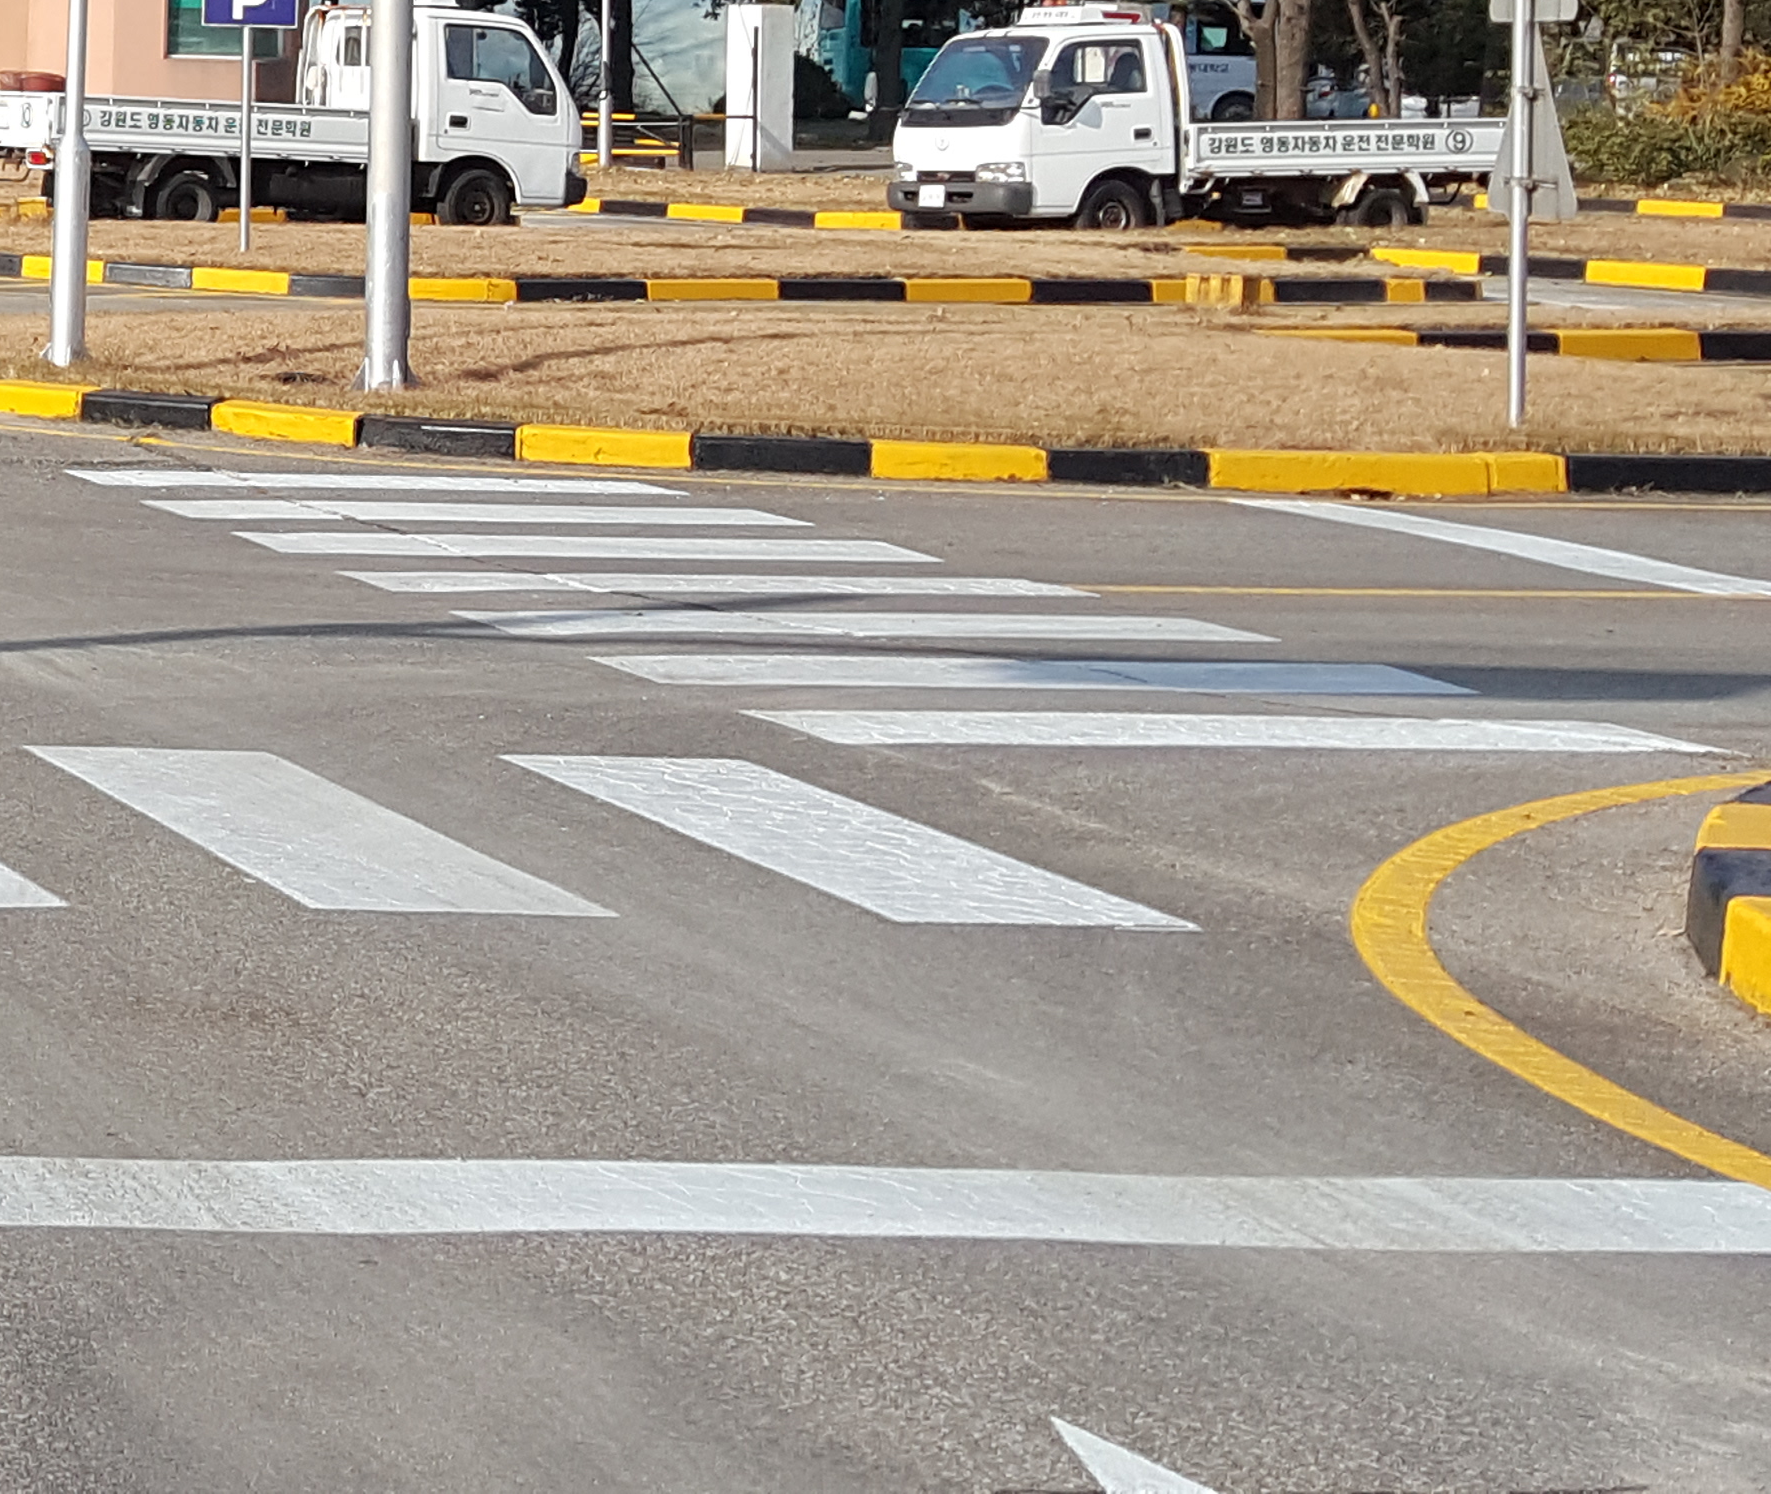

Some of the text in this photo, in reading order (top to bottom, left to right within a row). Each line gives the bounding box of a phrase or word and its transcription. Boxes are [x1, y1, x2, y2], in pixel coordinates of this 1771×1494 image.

[99, 110, 312, 138] 강원도 영동자동차 운 전문학원
[1208, 136, 1255, 155] 강원도
[1260, 135, 1338, 154] 영동자동차
[1341, 134, 1371, 153] 운전
[1375, 132, 1436, 152] 전문학원
